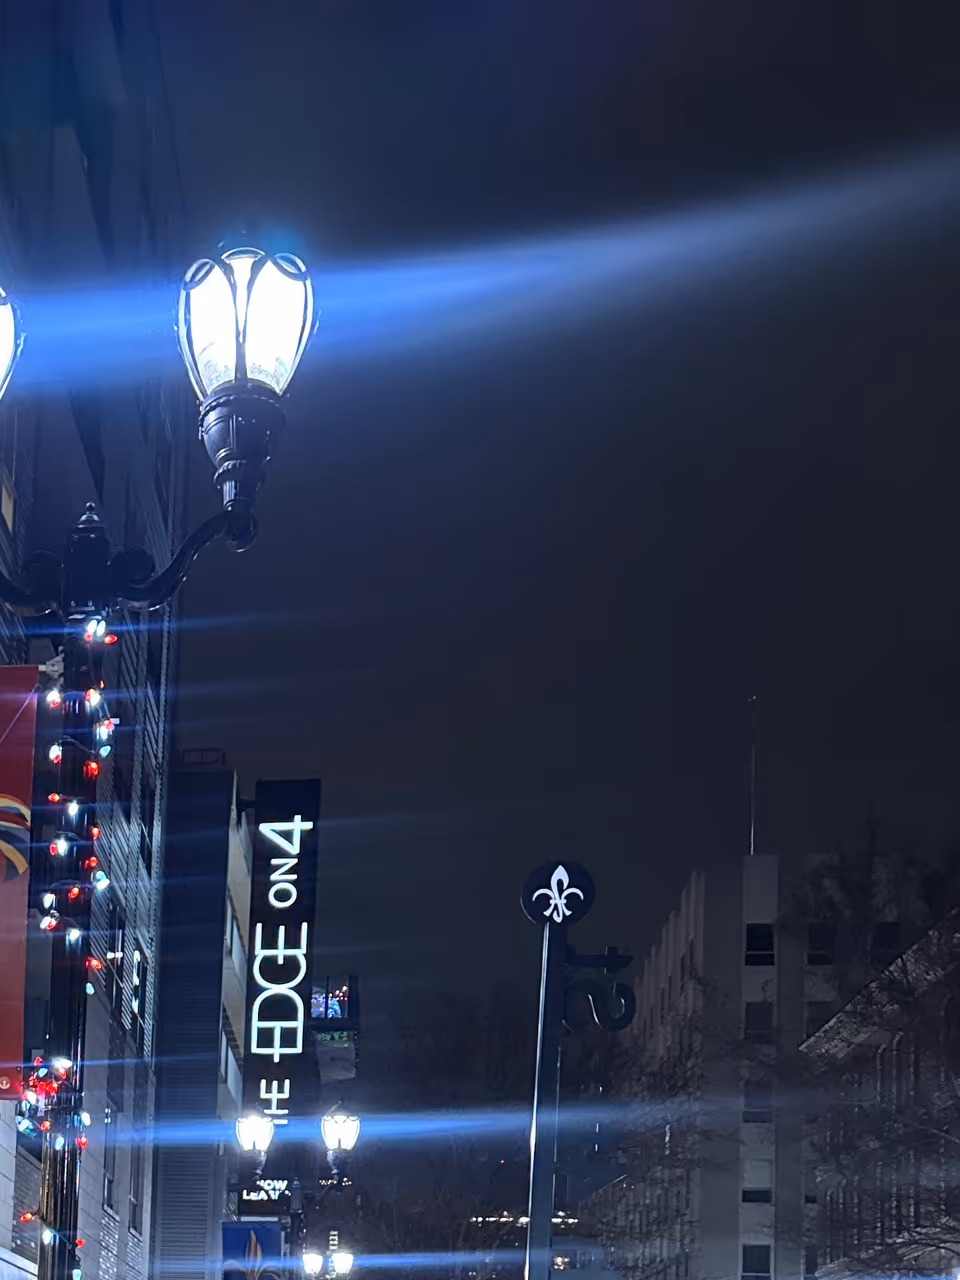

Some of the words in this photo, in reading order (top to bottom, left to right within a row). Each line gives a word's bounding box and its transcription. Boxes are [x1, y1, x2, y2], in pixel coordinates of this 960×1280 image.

[258, 814, 314, 855] 4
[268, 857, 299, 909] ON
[251, 921, 308, 1063] EDGE
